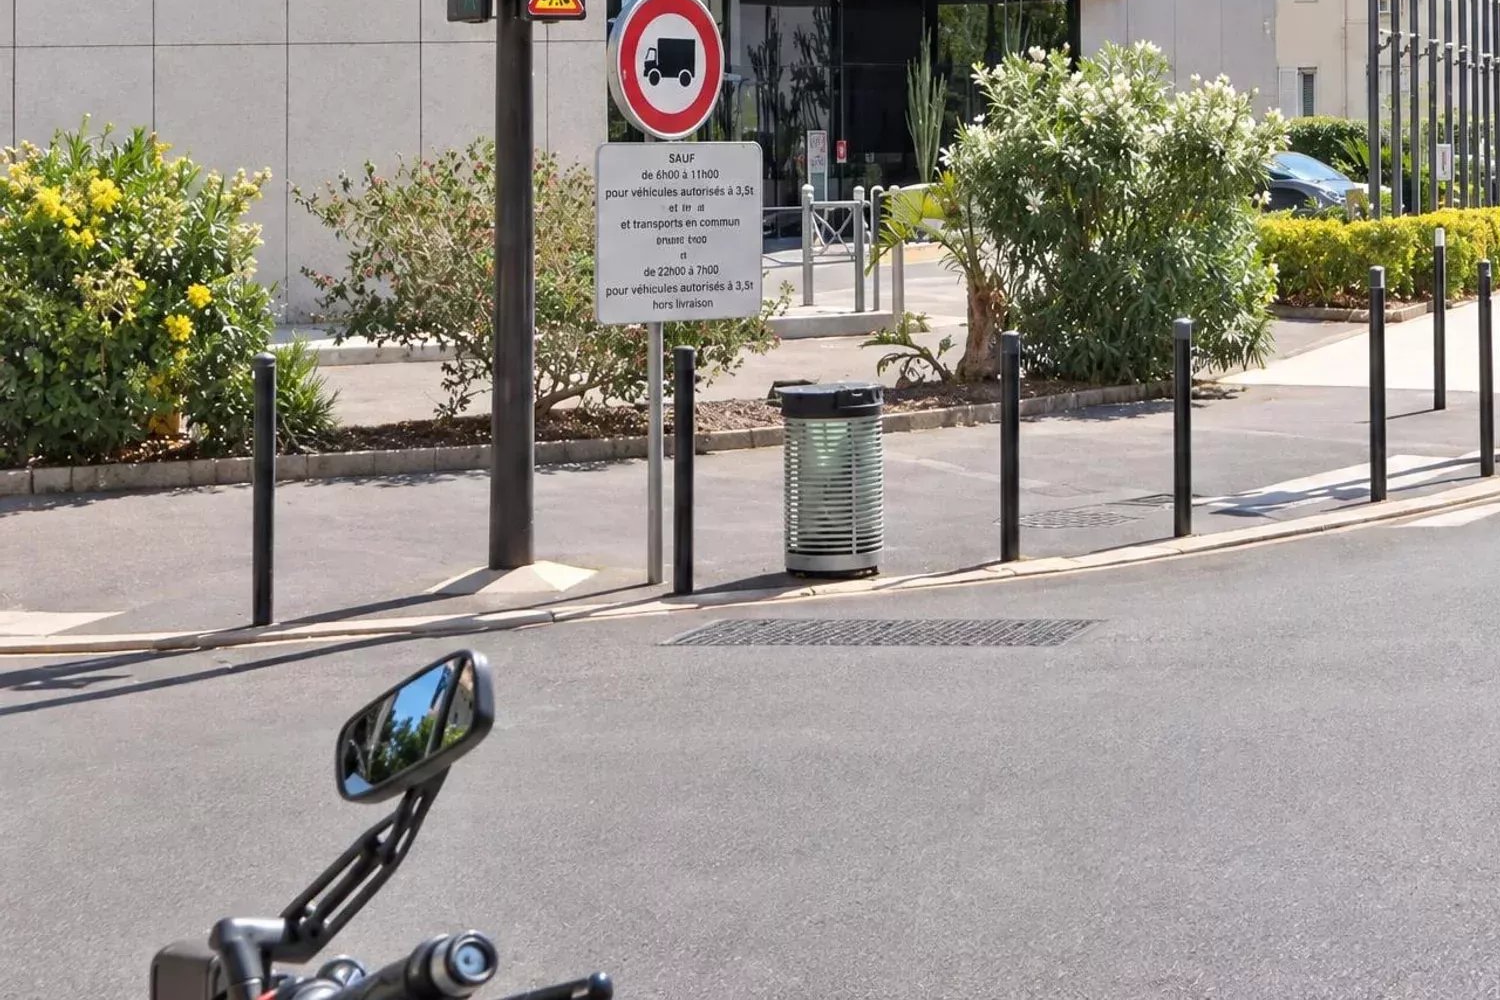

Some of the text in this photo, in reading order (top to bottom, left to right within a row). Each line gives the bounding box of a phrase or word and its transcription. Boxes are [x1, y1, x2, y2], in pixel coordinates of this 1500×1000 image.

[668, 153, 695, 164] SAUF
[641, 170, 653, 180] de
[656, 170, 680, 180] 6h00
[691, 169, 719, 179] 11h00
[605, 188, 629, 200] pour
[631, 187, 678, 198] véhicules
[680, 186, 725, 197] autorisés
[620, 218, 740, 231] et transports en commun
[643, 266, 656, 277] de
[658, 266, 686, 277] 22h00
[696, 265, 719, 275] 7h00
[605, 286, 629, 298] pour
[631, 284, 678, 295] véhicules
[680, 281, 726, 292] autorisés
[652, 298, 713, 310] hors livraison
